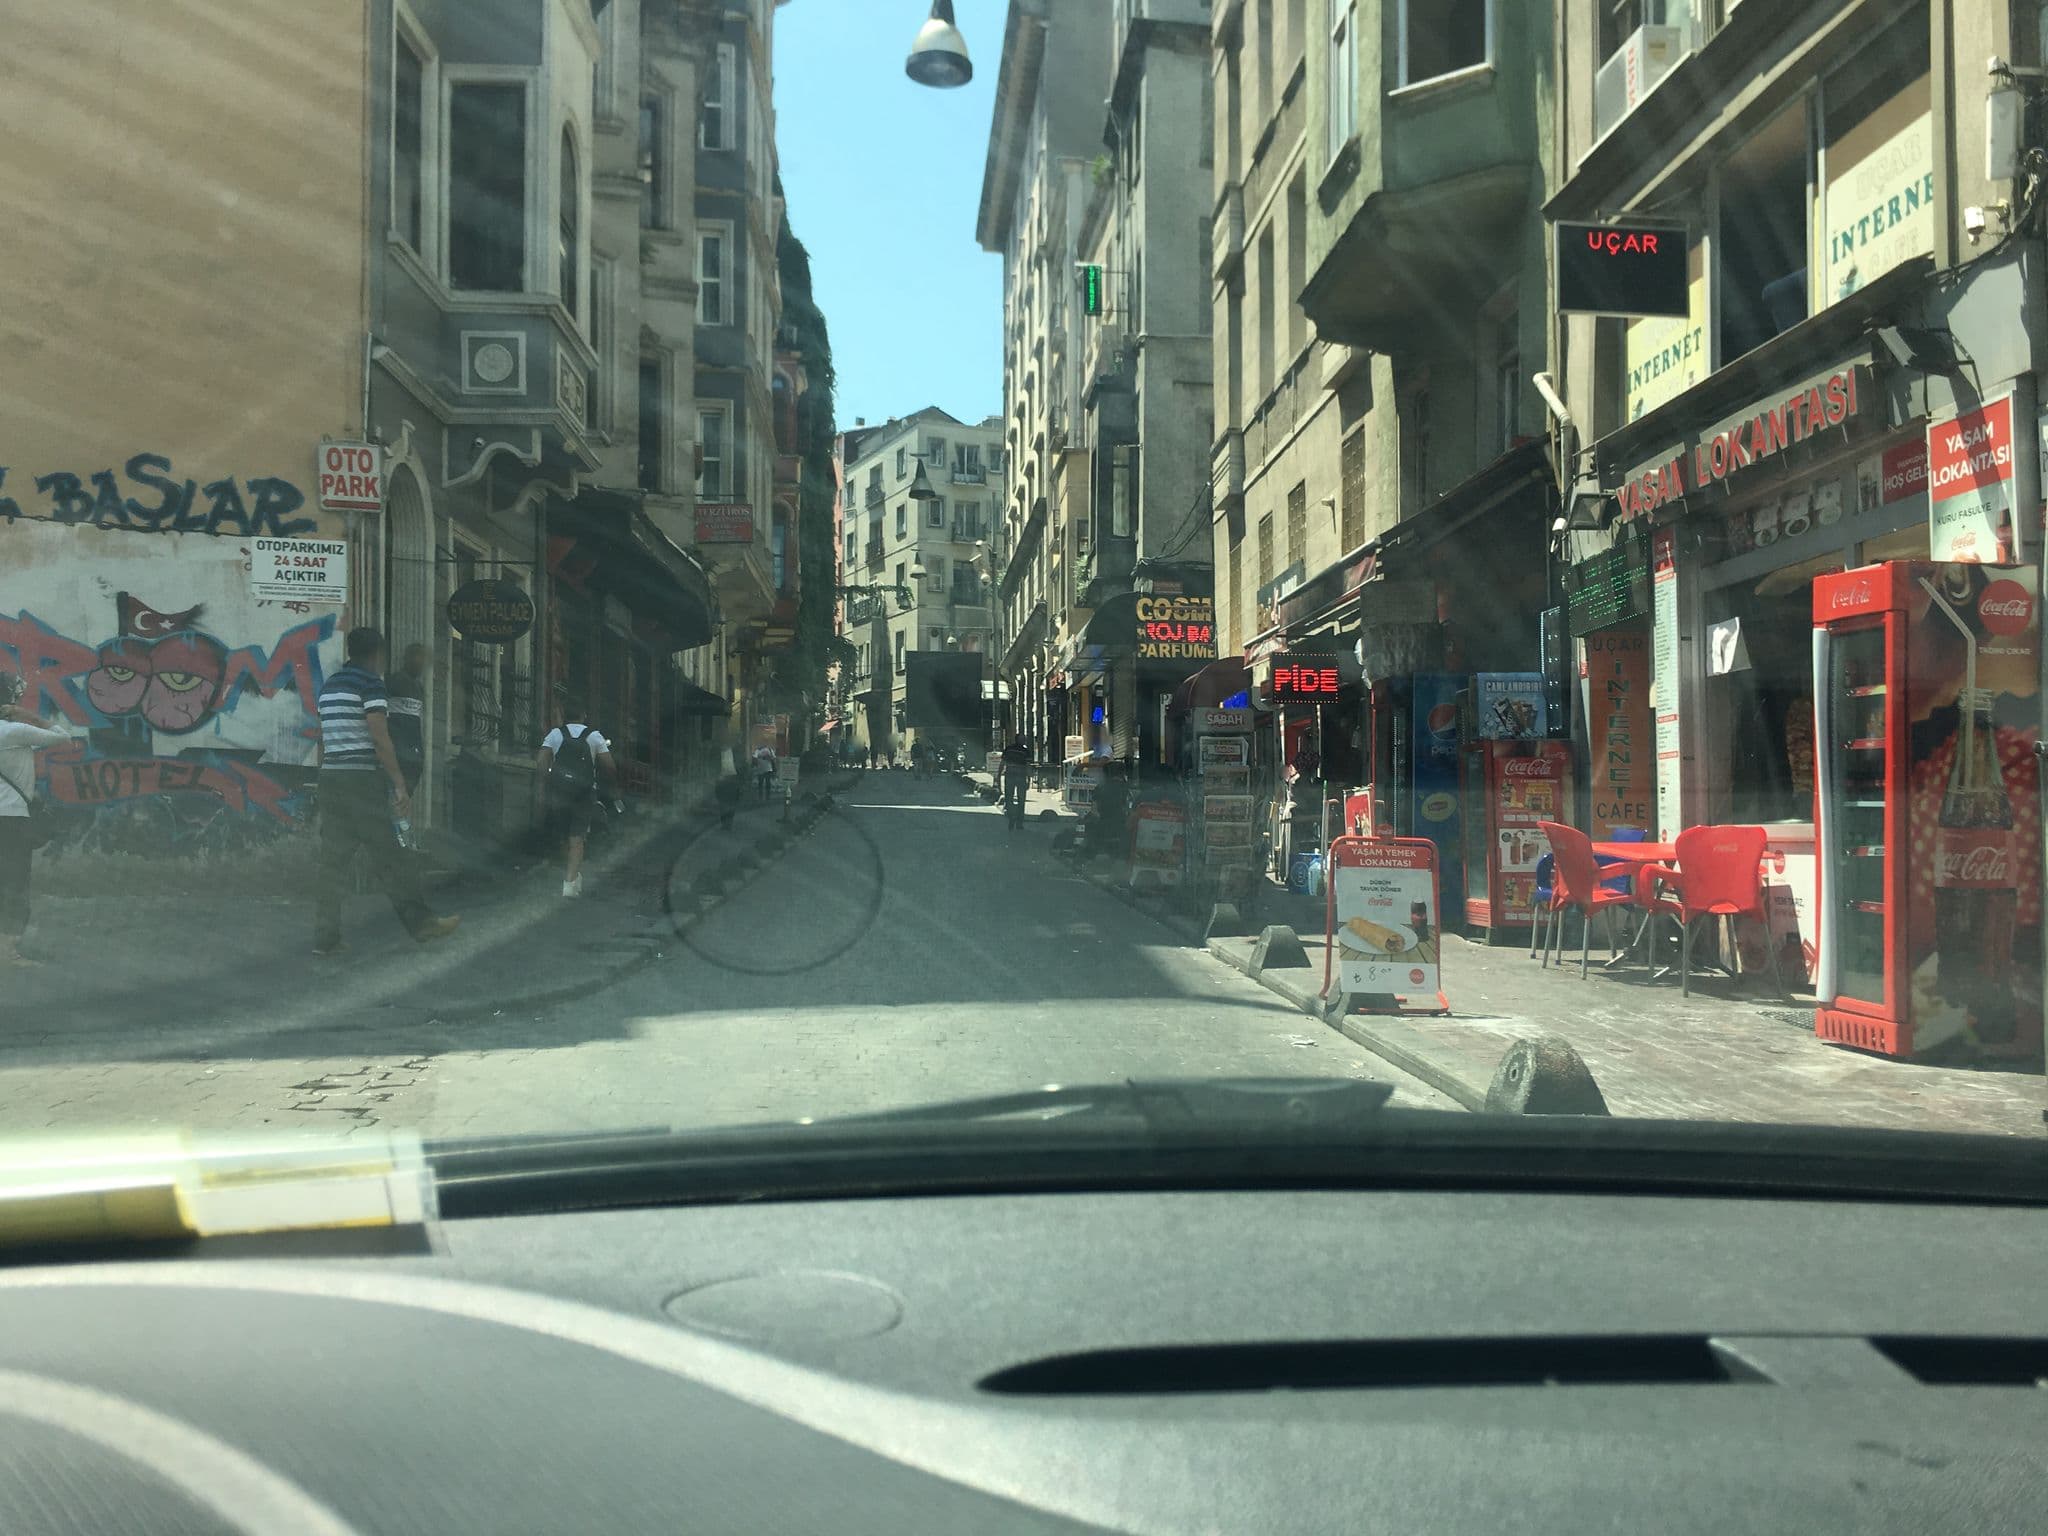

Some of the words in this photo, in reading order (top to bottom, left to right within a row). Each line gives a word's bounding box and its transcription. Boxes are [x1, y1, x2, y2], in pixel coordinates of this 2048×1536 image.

[1832, 172, 1933, 264] İNTERNE
[1587, 232, 1659, 256] UÇAR
[1695, 368, 1857, 488] LOKANTASI
[1945, 421, 1994, 454] YAŞAM
[326, 447, 373, 473] OTO
[1933, 443, 2010, 487] LOKANTASI
[34, 452, 317, 537] BAŞLAR
[321, 474, 380, 498] PARK
[1958, 502, 1991, 519] FASULYE
[256, 540, 344, 555] OTOPARKIMIZ
[274, 556, 289, 566] 24
[294, 556, 327, 568] SAAT
[275, 570, 326, 583] AÇIKTIR
[1137, 643, 1215, 658] PARFUME
[1593, 637, 1642, 655] UÇAR
[1274, 664, 1338, 692] PİDE
[1207, 714, 1243, 725] SABAH
[72, 760, 210, 800] HOTEL
[1597, 803, 1647, 820] CAFE
[1352, 848, 1383, 858] YAŞAM
[1386, 849, 1417, 857] YEMEK
[1360, 859, 1412, 868] LOKANTASI
